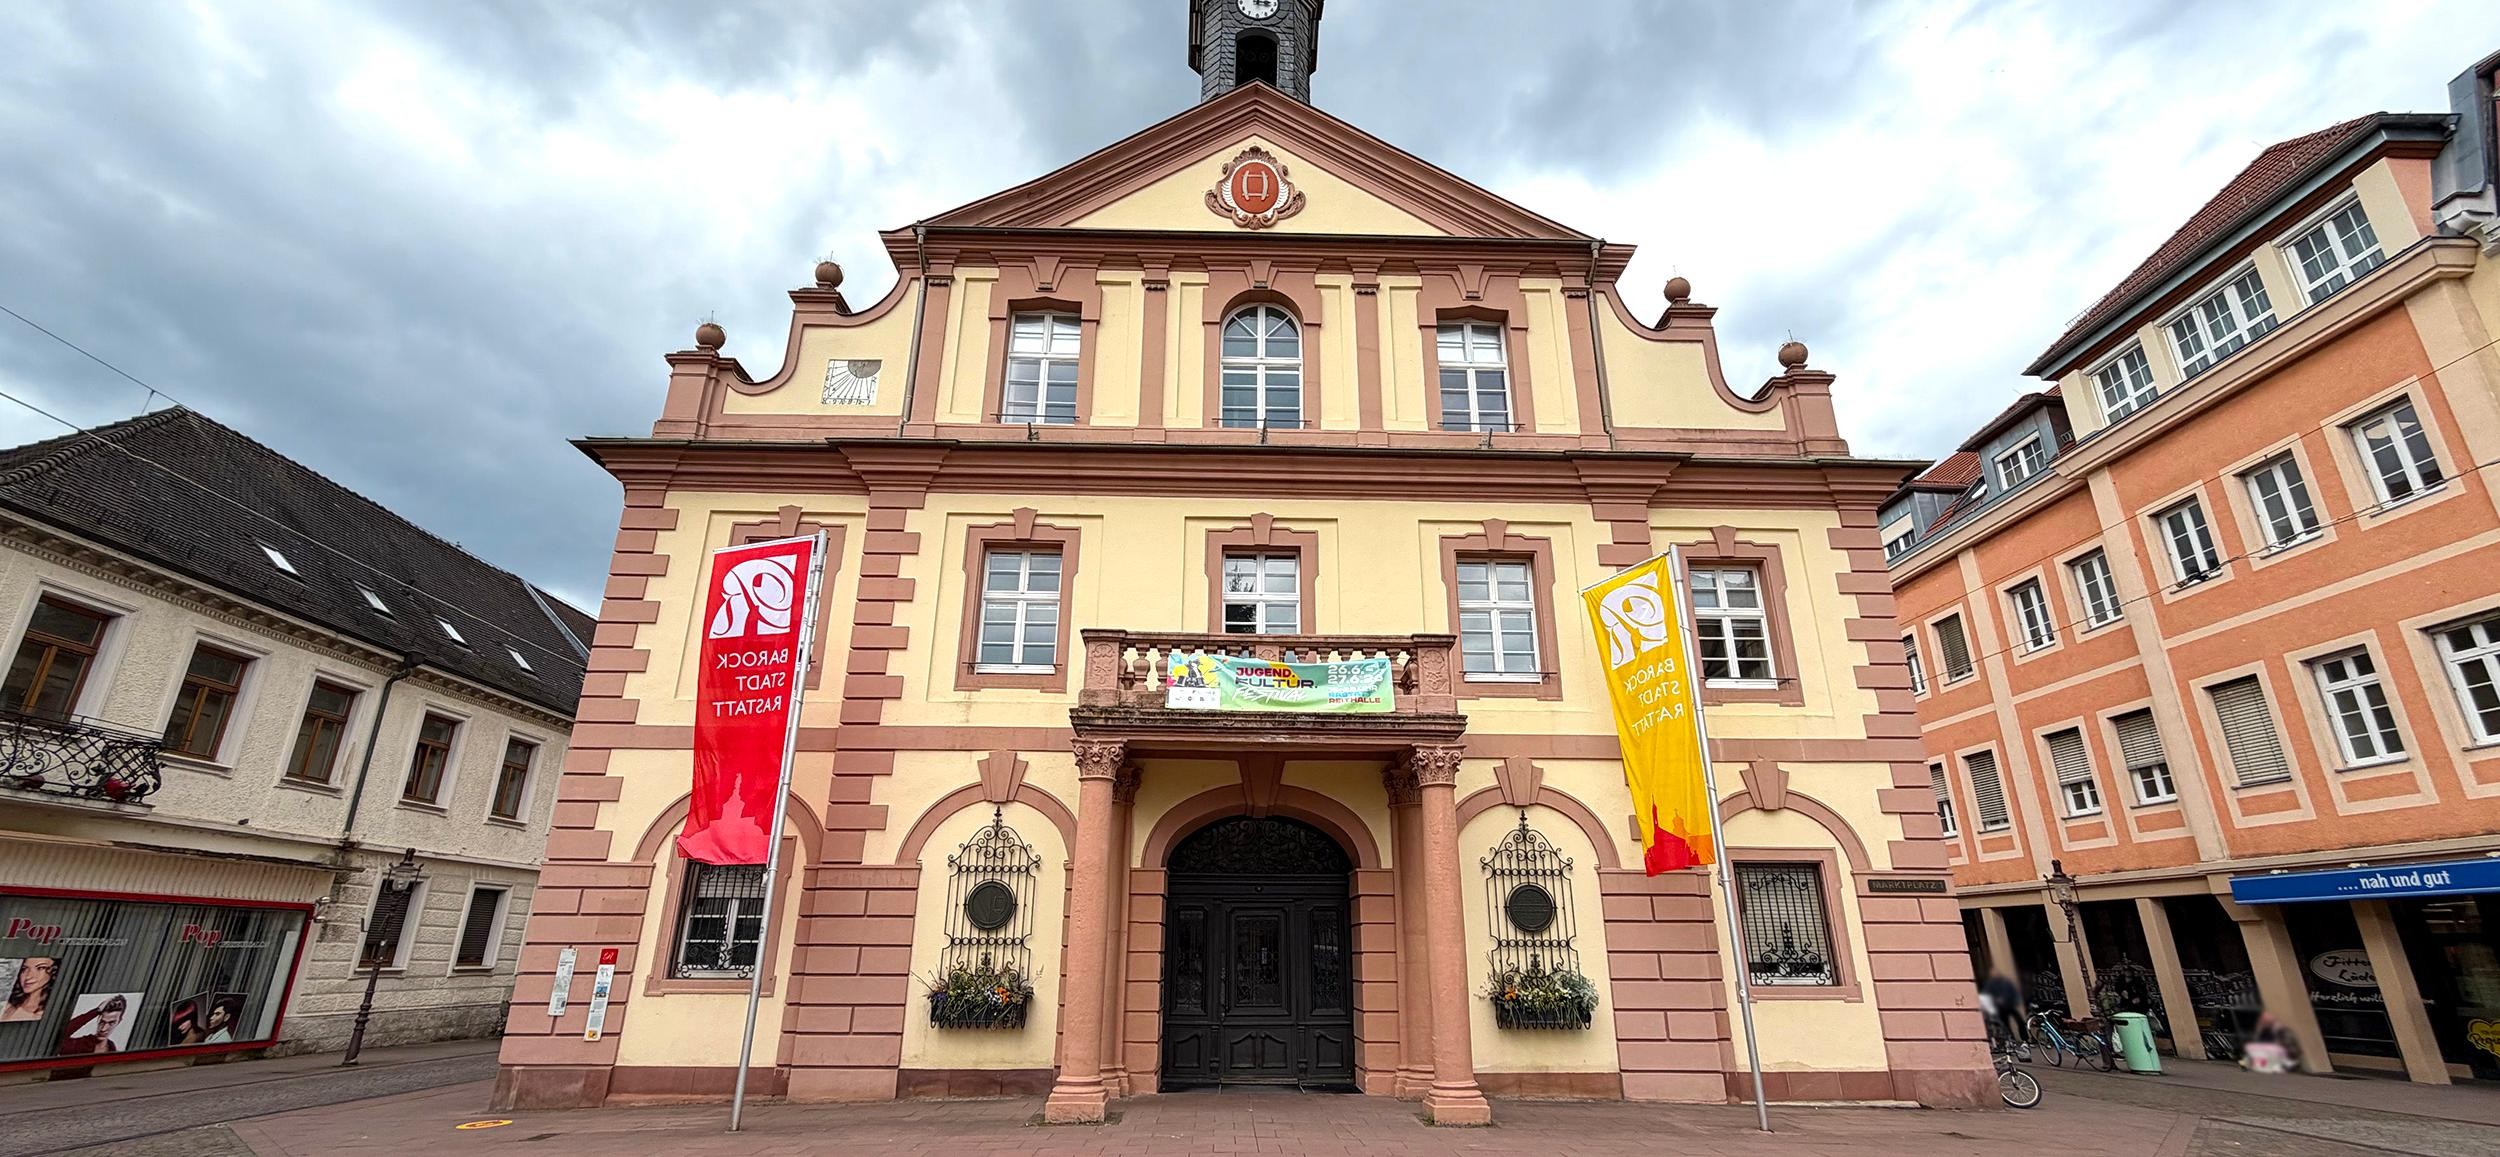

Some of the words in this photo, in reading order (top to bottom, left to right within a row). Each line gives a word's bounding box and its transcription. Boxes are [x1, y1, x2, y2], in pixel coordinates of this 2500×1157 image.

[1236, 667, 1296, 678] JUGEND.
[1872, 881, 1937, 889] MARKTPLATZ
[2359, 873, 2390, 889] nah
[2390, 871, 2422, 887] und
[2423, 870, 2451, 888] gut
[2, 917, 62, 945] Pop
[177, 923, 222, 948] Pop
[2339, 969, 2376, 982] Läde
